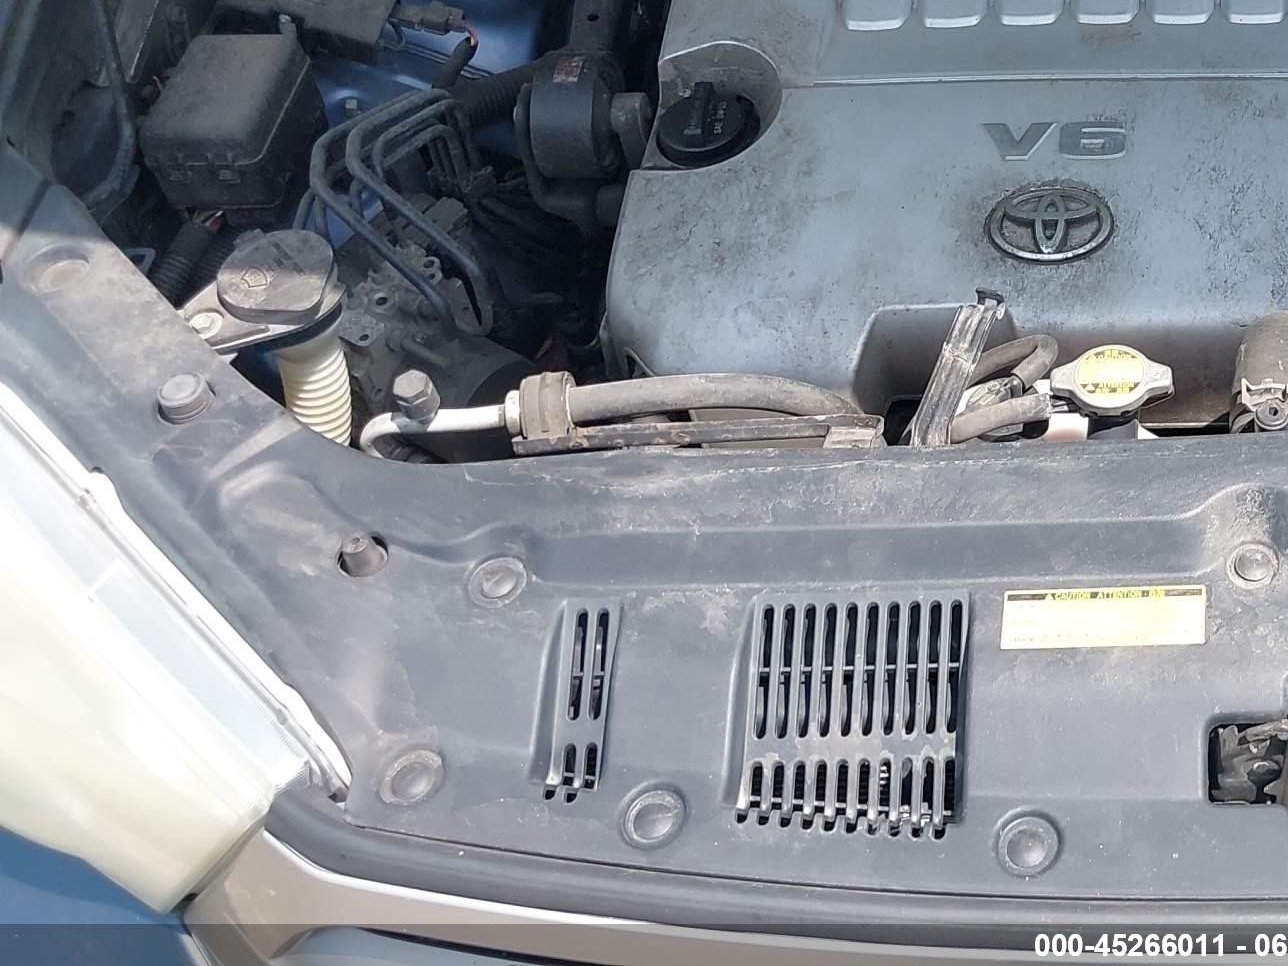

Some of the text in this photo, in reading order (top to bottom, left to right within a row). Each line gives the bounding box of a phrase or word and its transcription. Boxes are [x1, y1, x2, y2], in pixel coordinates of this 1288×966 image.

[981, 122, 1127, 161] V6
[1055, 591, 1091, 601] CAUTION
[1097, 590, 1141, 600] ATTENTION
